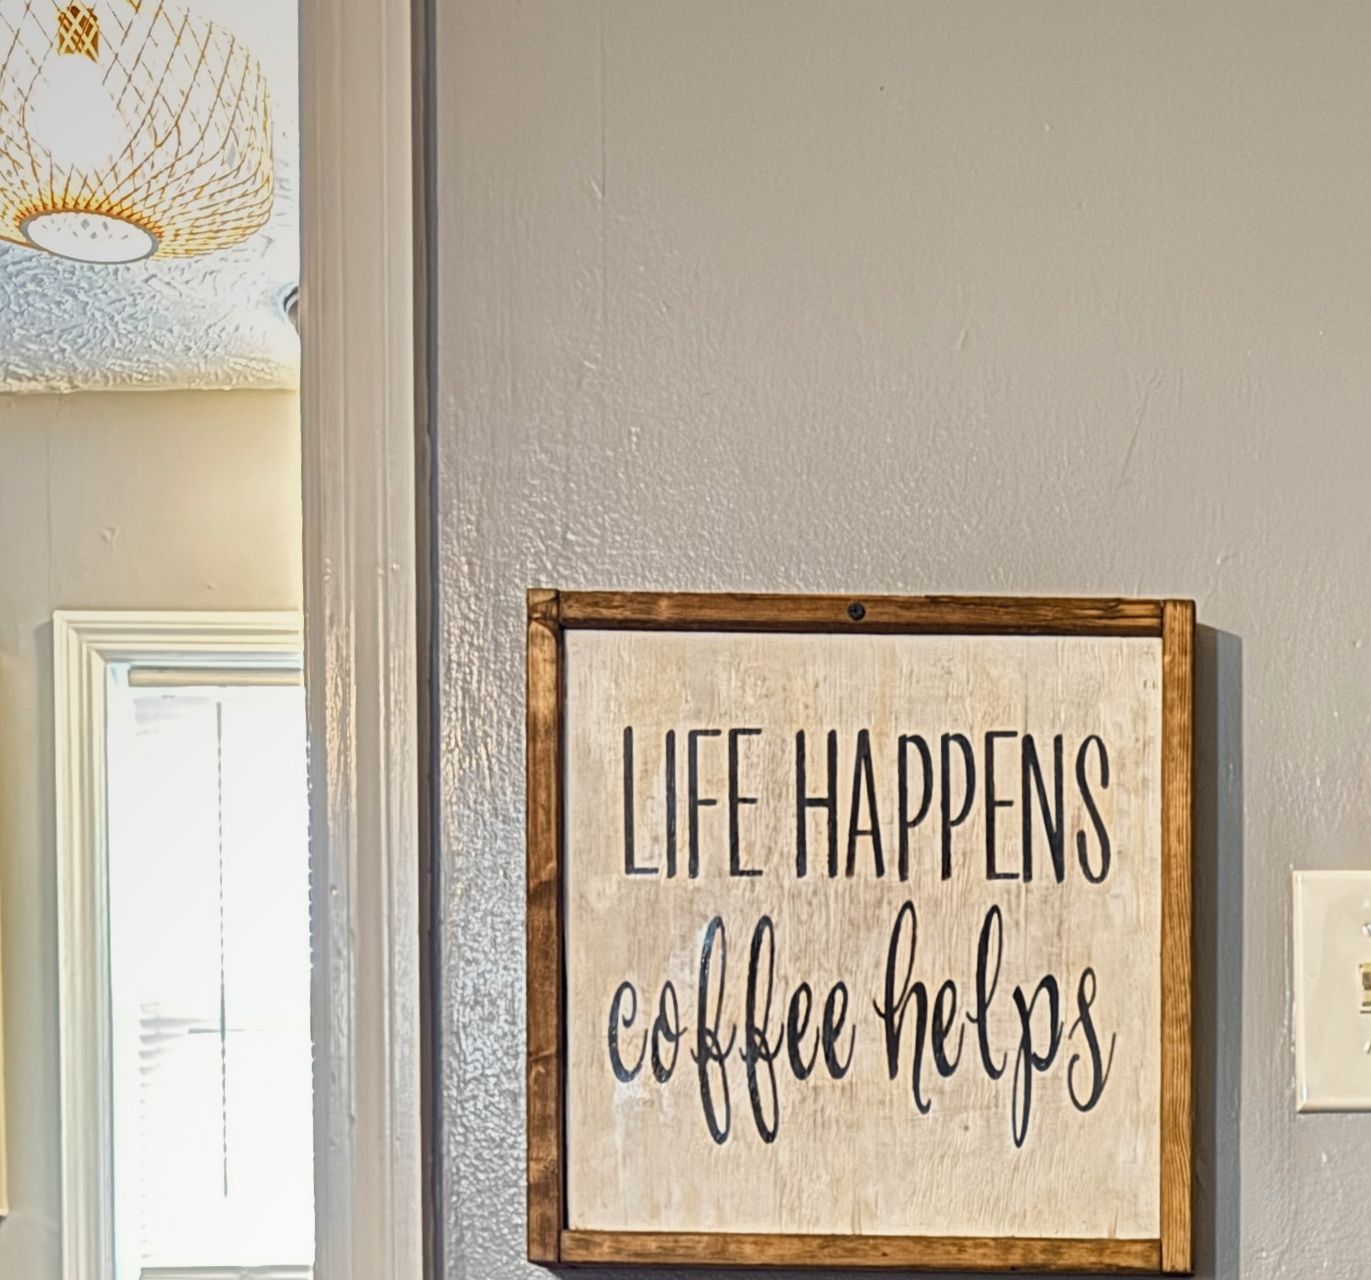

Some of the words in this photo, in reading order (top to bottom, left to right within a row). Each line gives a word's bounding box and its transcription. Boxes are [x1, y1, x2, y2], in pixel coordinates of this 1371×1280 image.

[622, 725, 764, 880] LIFE
[794, 727, 1112, 885] HAPPENS
[607, 914, 857, 1145] coffee
[873, 899, 1117, 1149] helps
